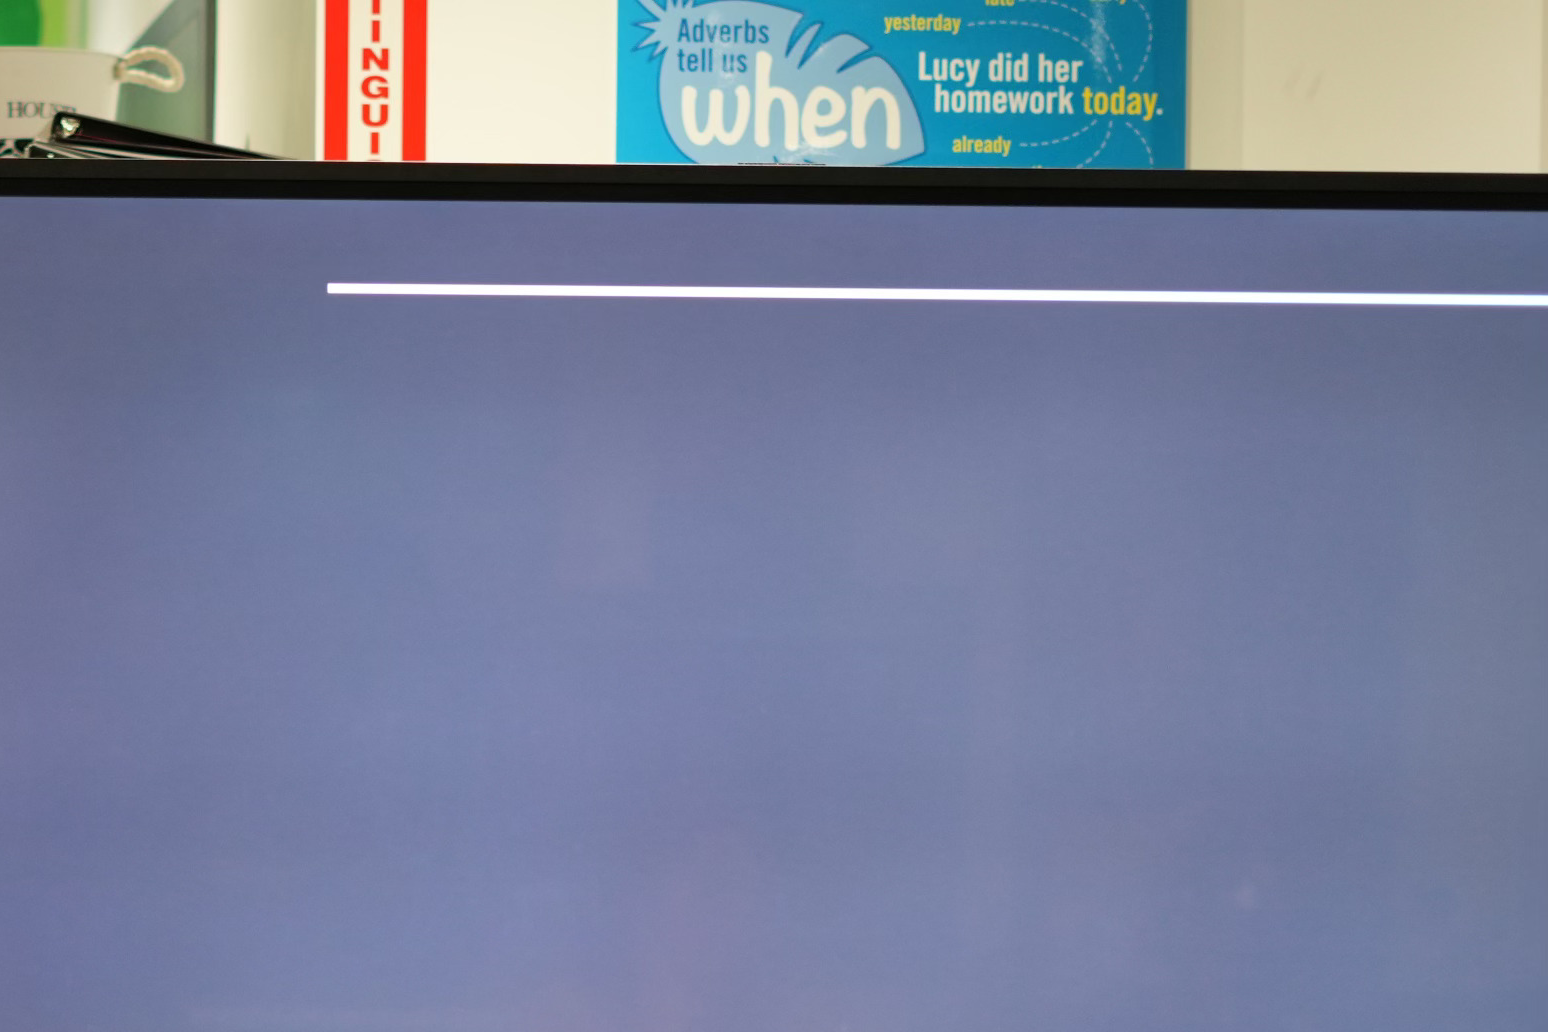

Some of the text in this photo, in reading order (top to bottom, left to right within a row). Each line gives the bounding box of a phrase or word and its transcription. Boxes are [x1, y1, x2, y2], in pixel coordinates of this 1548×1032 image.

[677, 18, 770, 44] Adverbs
[884, 14, 961, 34] yesterday
[677, 48, 749, 73] tell us
[918, 51, 1084, 87] Lucy did her
[361, 0, 389, 161] INGUI
[681, 50, 902, 151] when
[934, 83, 1163, 121] homework today.
[952, 136, 1012, 156] already
